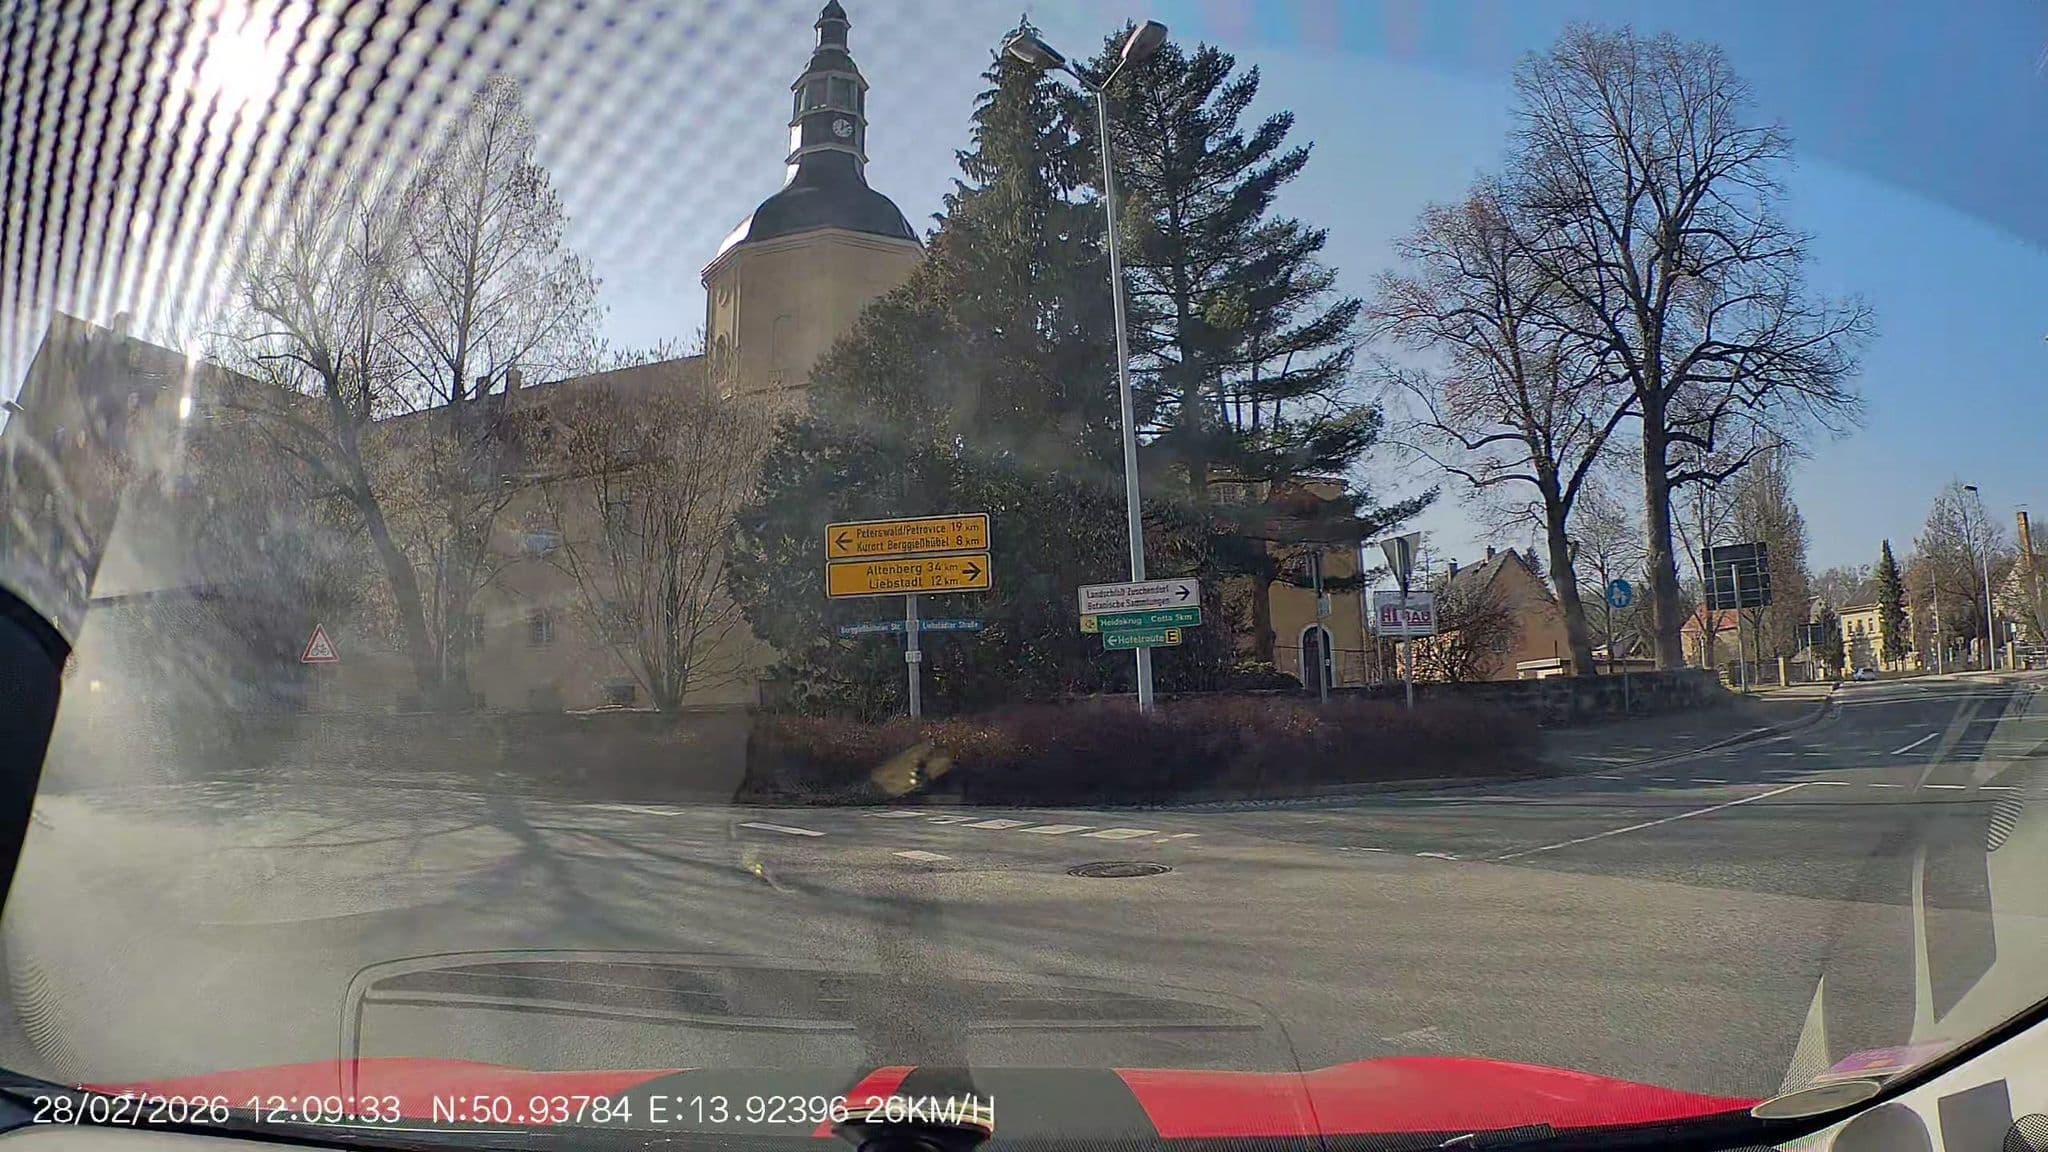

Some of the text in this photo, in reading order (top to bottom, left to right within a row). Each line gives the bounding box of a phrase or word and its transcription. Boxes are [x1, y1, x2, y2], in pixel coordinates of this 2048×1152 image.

[856, 521, 979, 539] Peterswald/Petrovice 19 km
[856, 541, 884, 553] Kurort
[956, 534, 963, 546] 8
[965, 537, 980, 546] km
[866, 561, 958, 576] Altenberg 34 km
[869, 575, 958, 589] Liebstadt 12 km
[1118, 630, 1177, 645] Hotelroute E
